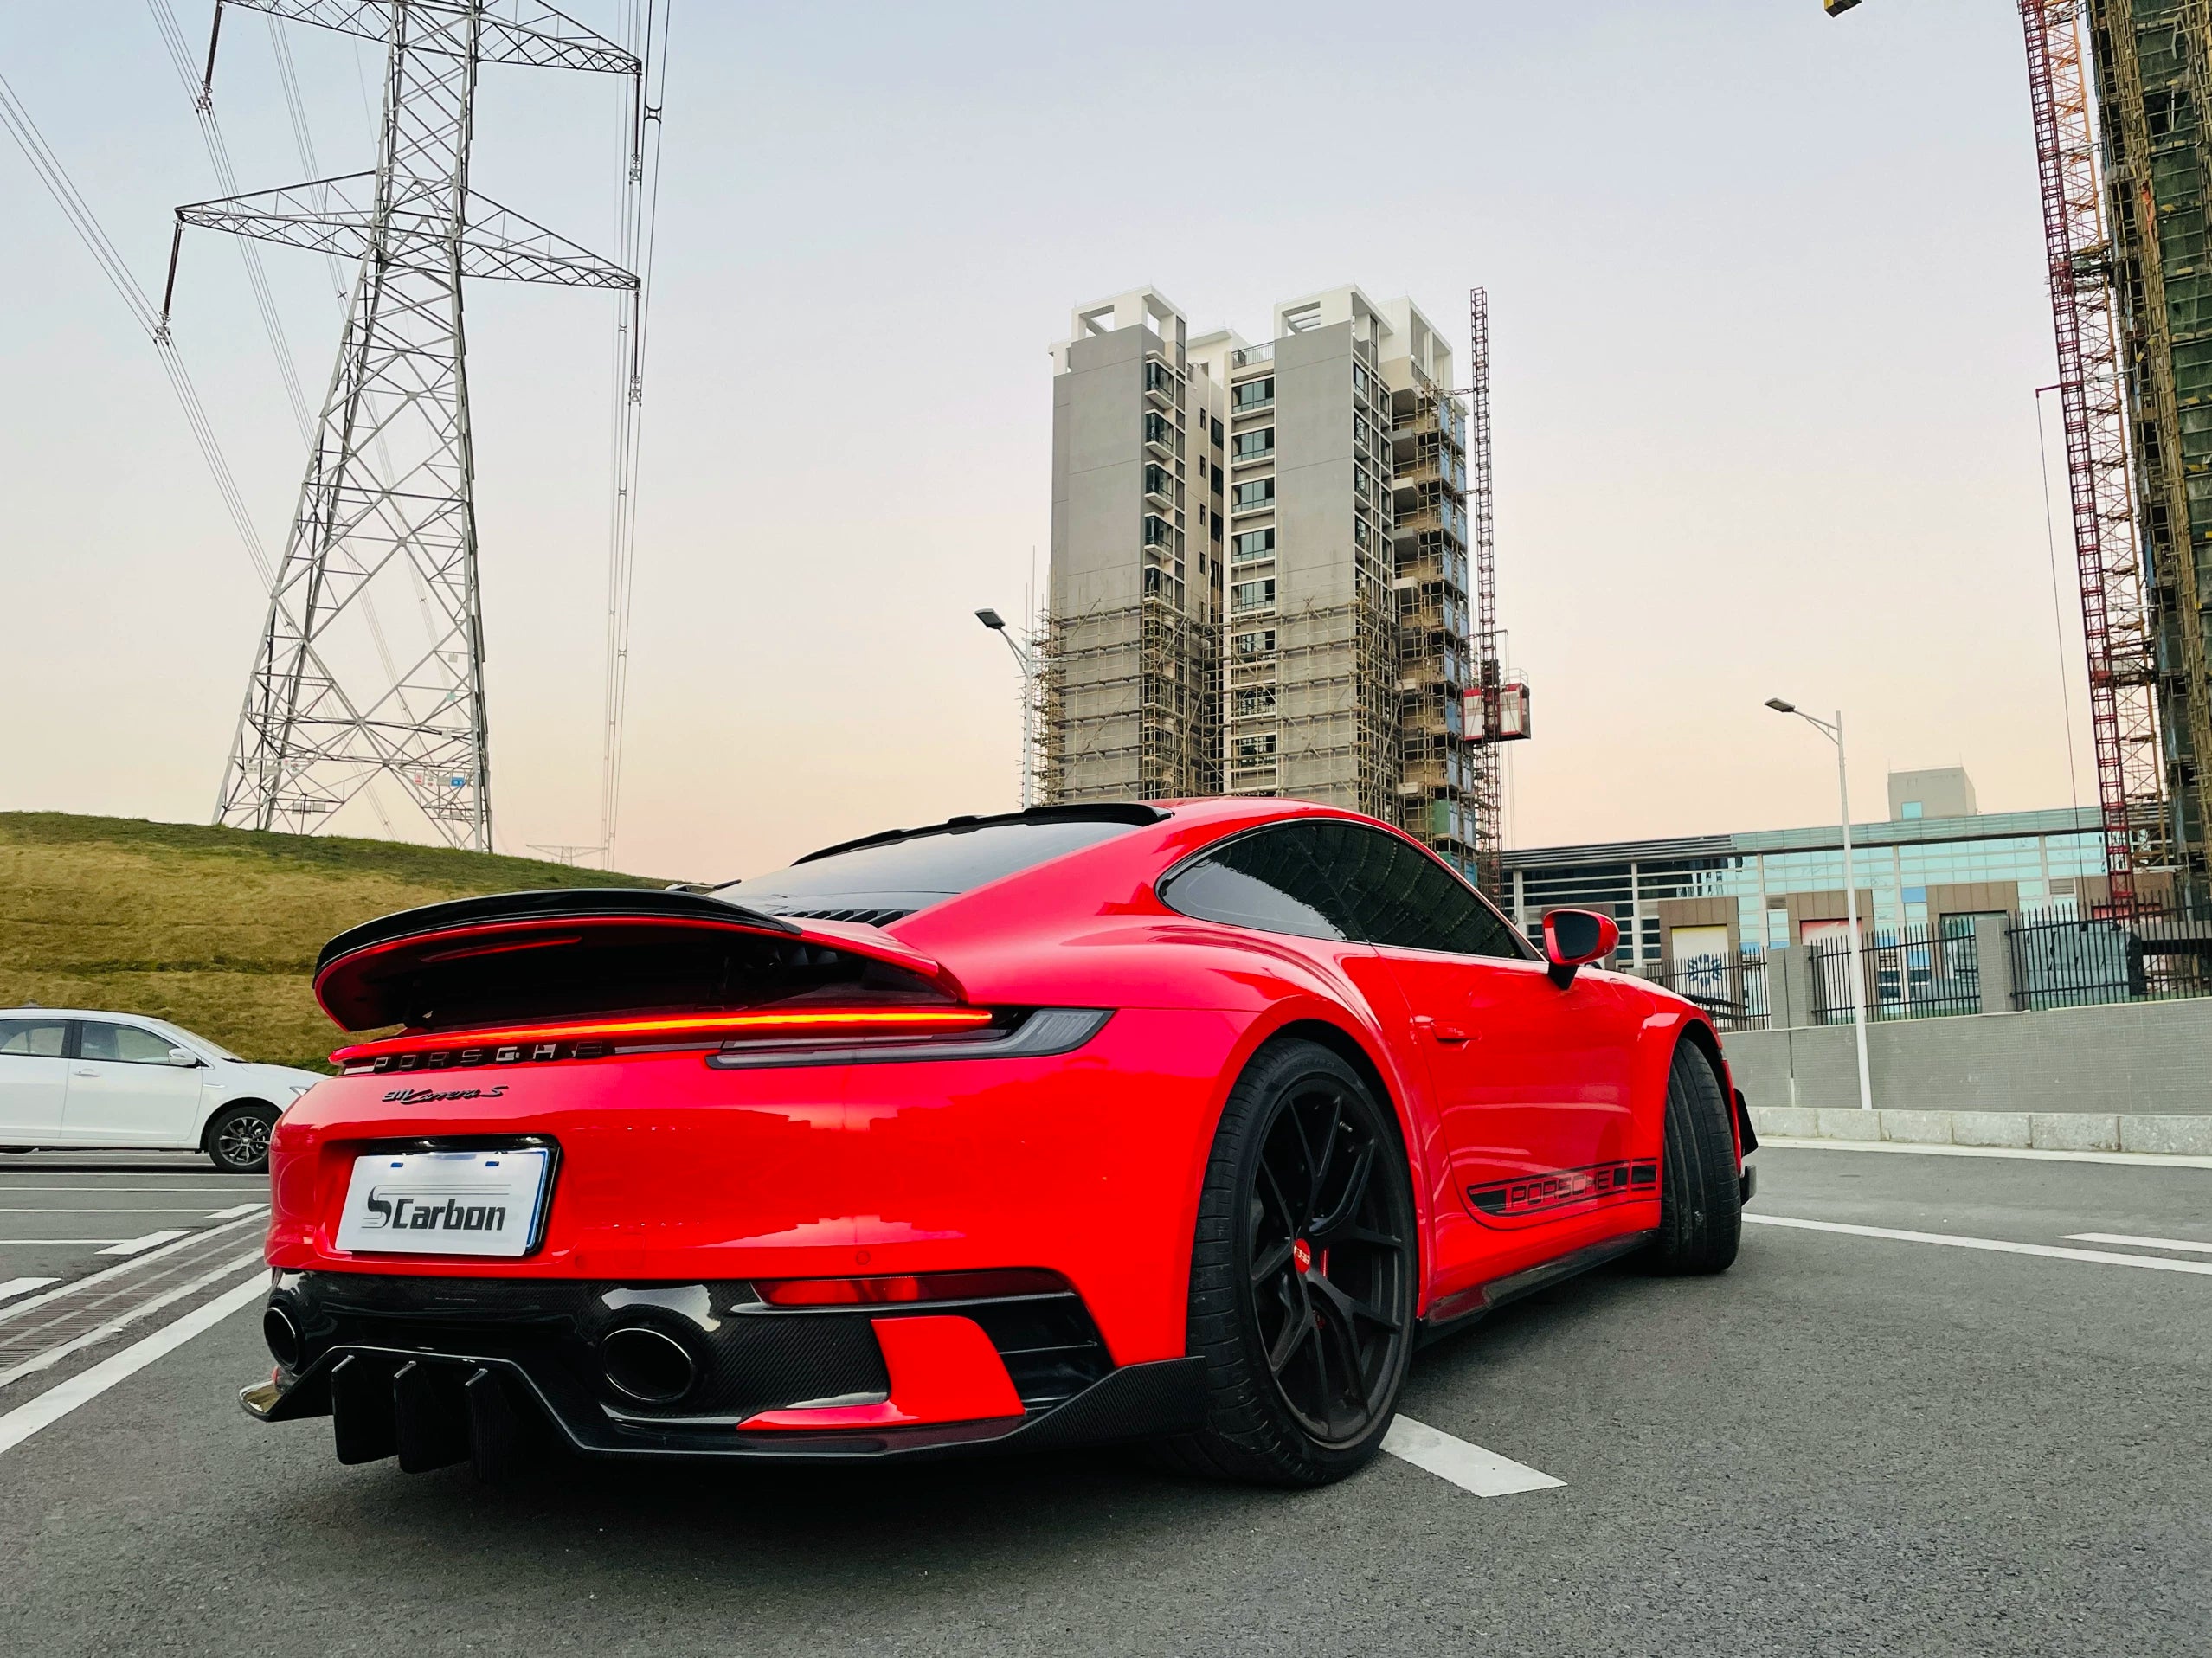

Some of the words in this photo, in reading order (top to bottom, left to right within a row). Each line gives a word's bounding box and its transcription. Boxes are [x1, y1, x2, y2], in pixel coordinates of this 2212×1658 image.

[373, 1041, 603, 1073] PORSCHE
[480, 1085, 509, 1098] S
[1511, 1170, 1611, 1208] PORSCHE
